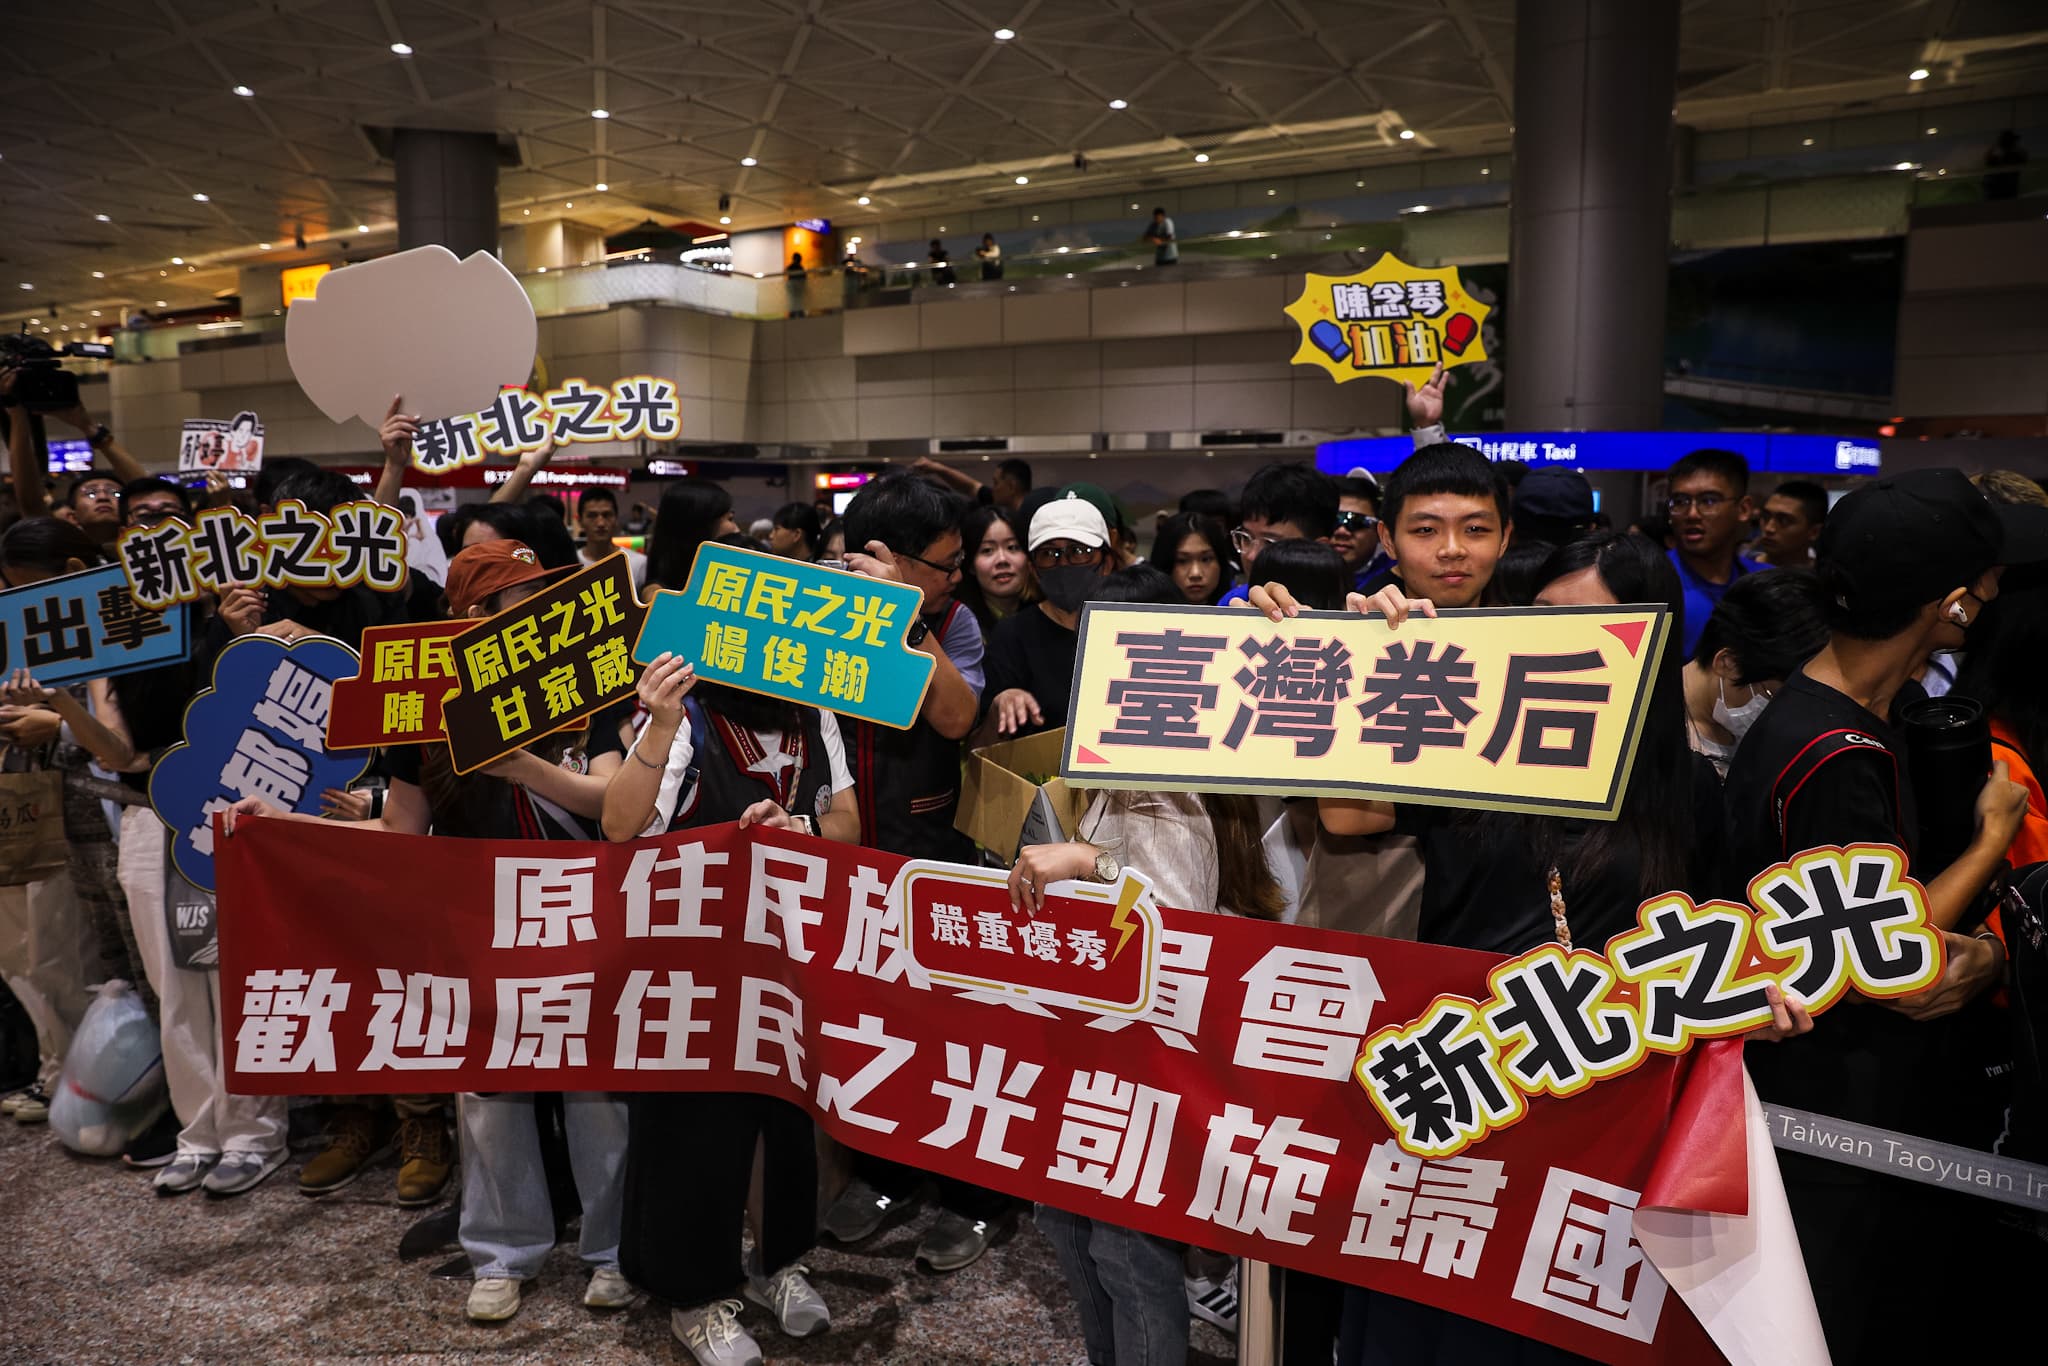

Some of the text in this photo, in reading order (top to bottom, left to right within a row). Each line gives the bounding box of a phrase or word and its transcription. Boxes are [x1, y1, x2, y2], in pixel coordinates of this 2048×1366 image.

[1331, 280, 1448, 320] 陳念琴
[1349, 322, 1441, 368] 加油
[417, 383, 675, 466] 新北之光
[1541, 443, 1576, 460] Taxi
[125, 510, 397, 600] 新北之光
[0, 585, 171, 674] 出擊
[463, 576, 626, 693] 原民之光
[696, 561, 898, 648] 原民之光
[491, 636, 634, 741] 甘家葳
[701, 621, 869, 703] 楊俊瀚
[1097, 628, 1612, 769] 臺灣拳后
[176, 905, 209, 928] WJS
[929, 902, 1107, 971] 嚴重優秀
[491, 841, 1386, 1082] 原住民族員會
[1369, 862, 1924, 1145] 新北之光
[234, 967, 1669, 1344] 歡迎原住民之光凱旋歸國
[1778, 1114, 1873, 1159] Taiwan
[1883, 1139, 2013, 1192] Taoyuan
